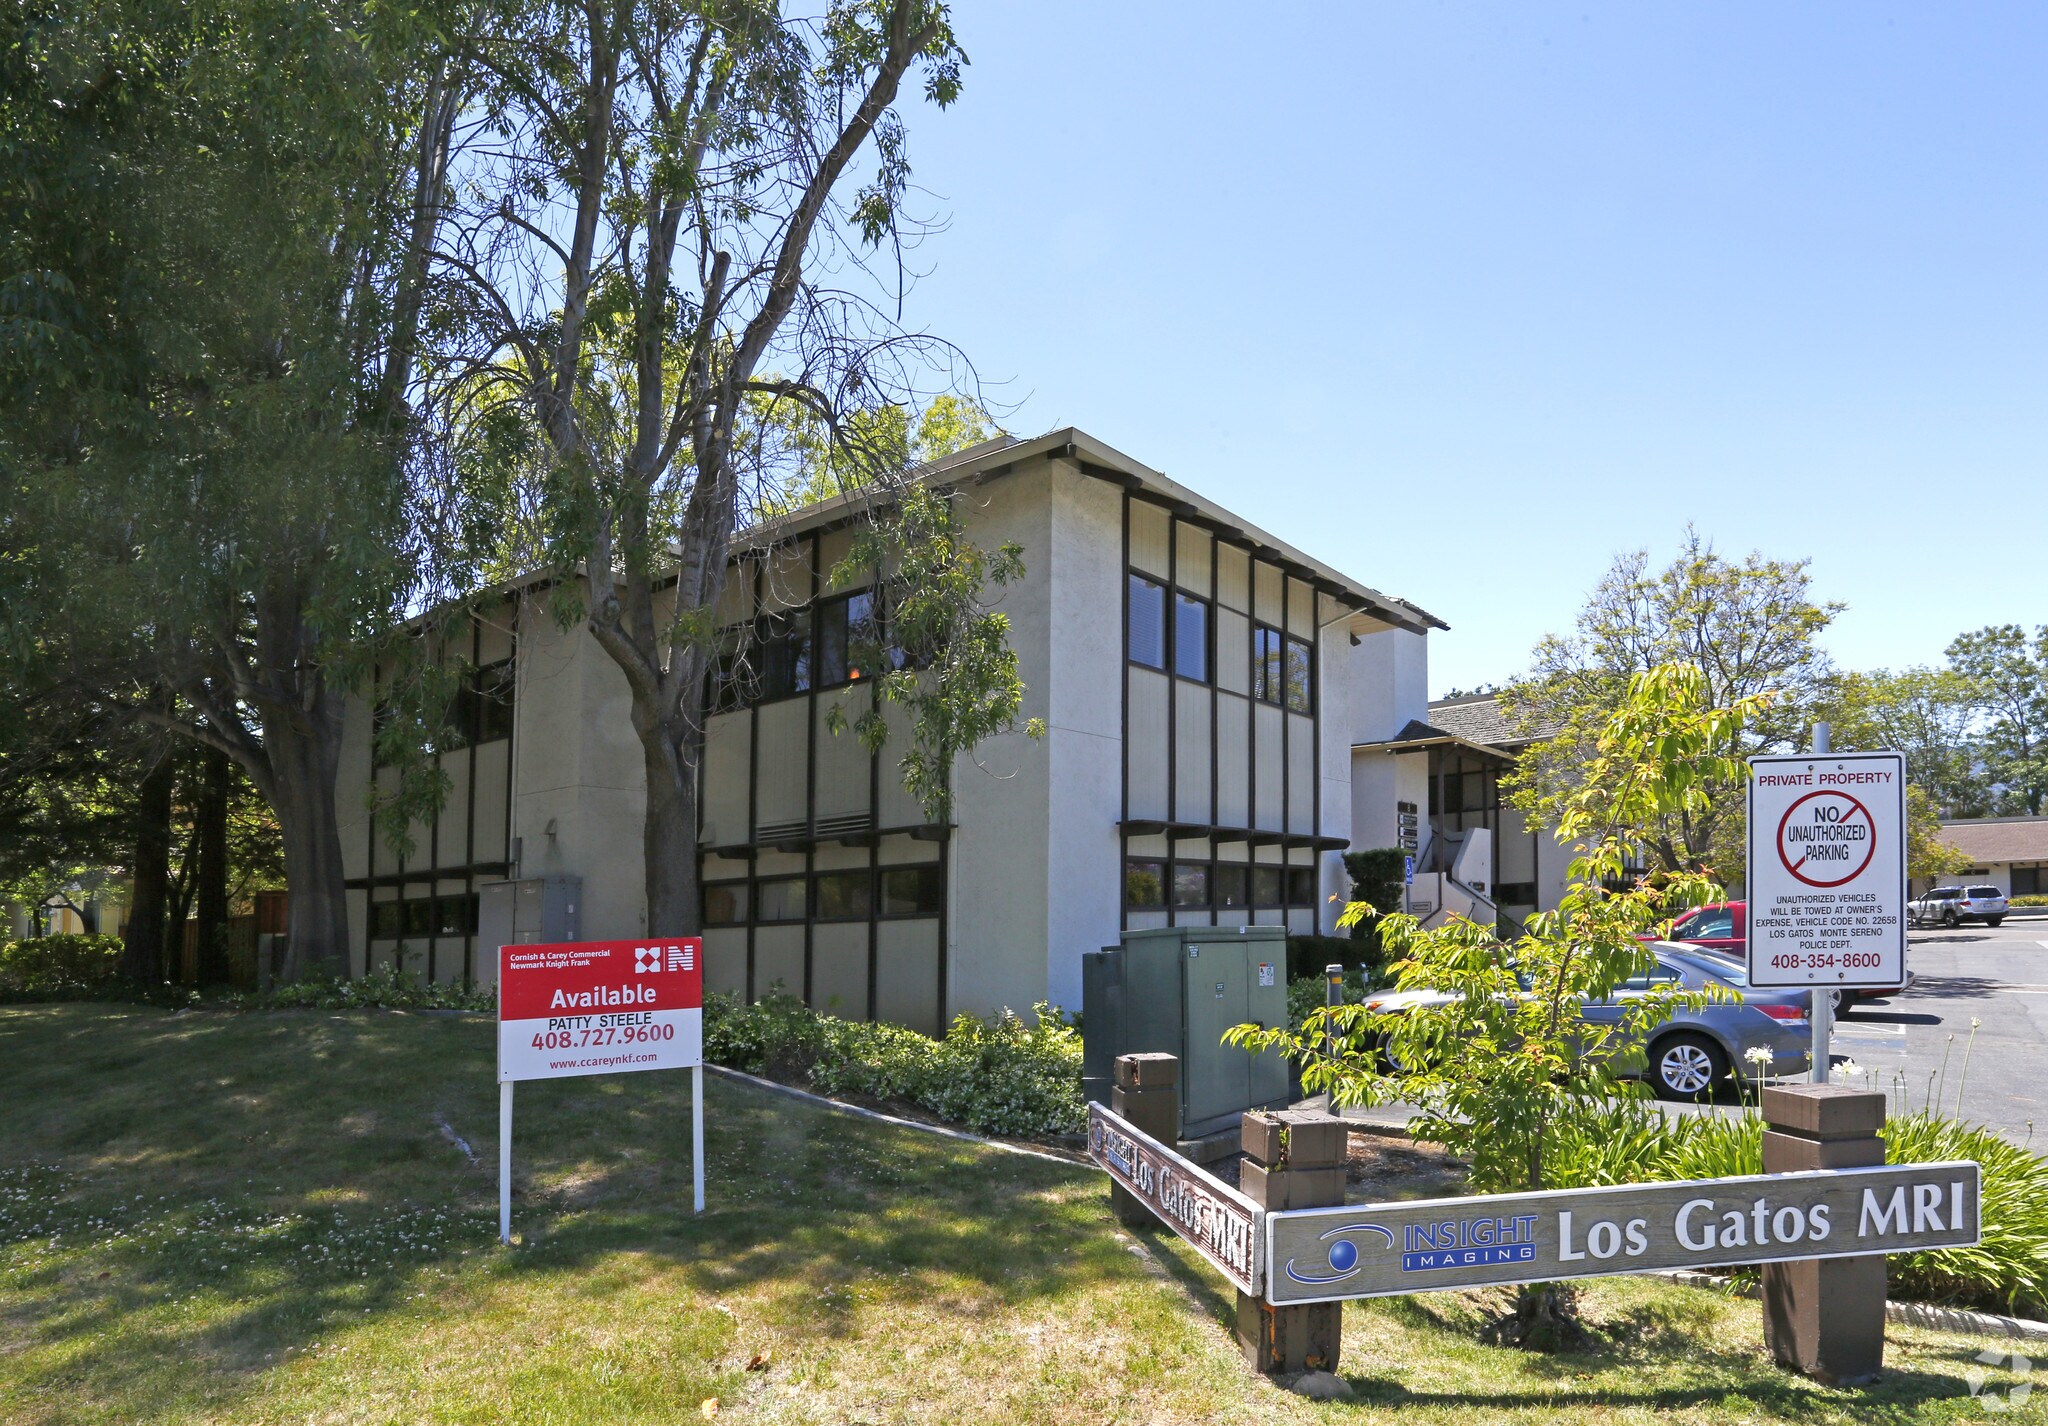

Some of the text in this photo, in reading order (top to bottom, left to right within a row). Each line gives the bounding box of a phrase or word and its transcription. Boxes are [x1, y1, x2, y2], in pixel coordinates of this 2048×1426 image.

[1759, 772, 1892, 786] PRIVATE PROPERTY
[1814, 806, 1839, 823] NO
[1788, 825, 1866, 842] UNAUTHORIZED
[1806, 844, 1849, 861] PARKING
[1776, 894, 1876, 904] UNAUTHORIZED VEHICLES
[1770, 908, 1788, 916] WILL
[1791, 907, 1801, 916] BE
[1834, 906, 1843, 914] AT
[1846, 905, 1883, 914] OWNER'S
[1756, 916, 1897, 928] EXPENSE, VEHICLE CODE NO. 22658
[1769, 928, 1883, 938] LOS GATOS MONTE SERENO
[1799, 940, 1852, 950] POLICE DEPT.
[510, 953, 538, 961] Cornish
[547, 952, 567, 960] Carey
[568, 950, 610, 958] Commercial
[1771, 953, 1881, 969] 408-354-8600
[510, 962, 544, 970] Newmark
[545, 960, 570, 968] Knight
[550, 983, 656, 1009] Available
[549, 1012, 652, 1031] PATTY STEELE
[532, 1024, 674, 1050] 408.727.9600
[550, 1052, 657, 1070] www.ccareynkf.com
[1133, 1146, 1154, 1195] Los
[1159, 1166, 1204, 1235] Gatos
[1210, 1196, 1249, 1273] MRI
[1558, 1182, 1964, 1262] Los Gatos MRI
[1404, 1215, 1538, 1252] INSIGHT
[1406, 1247, 1532, 1268] IMAGING
